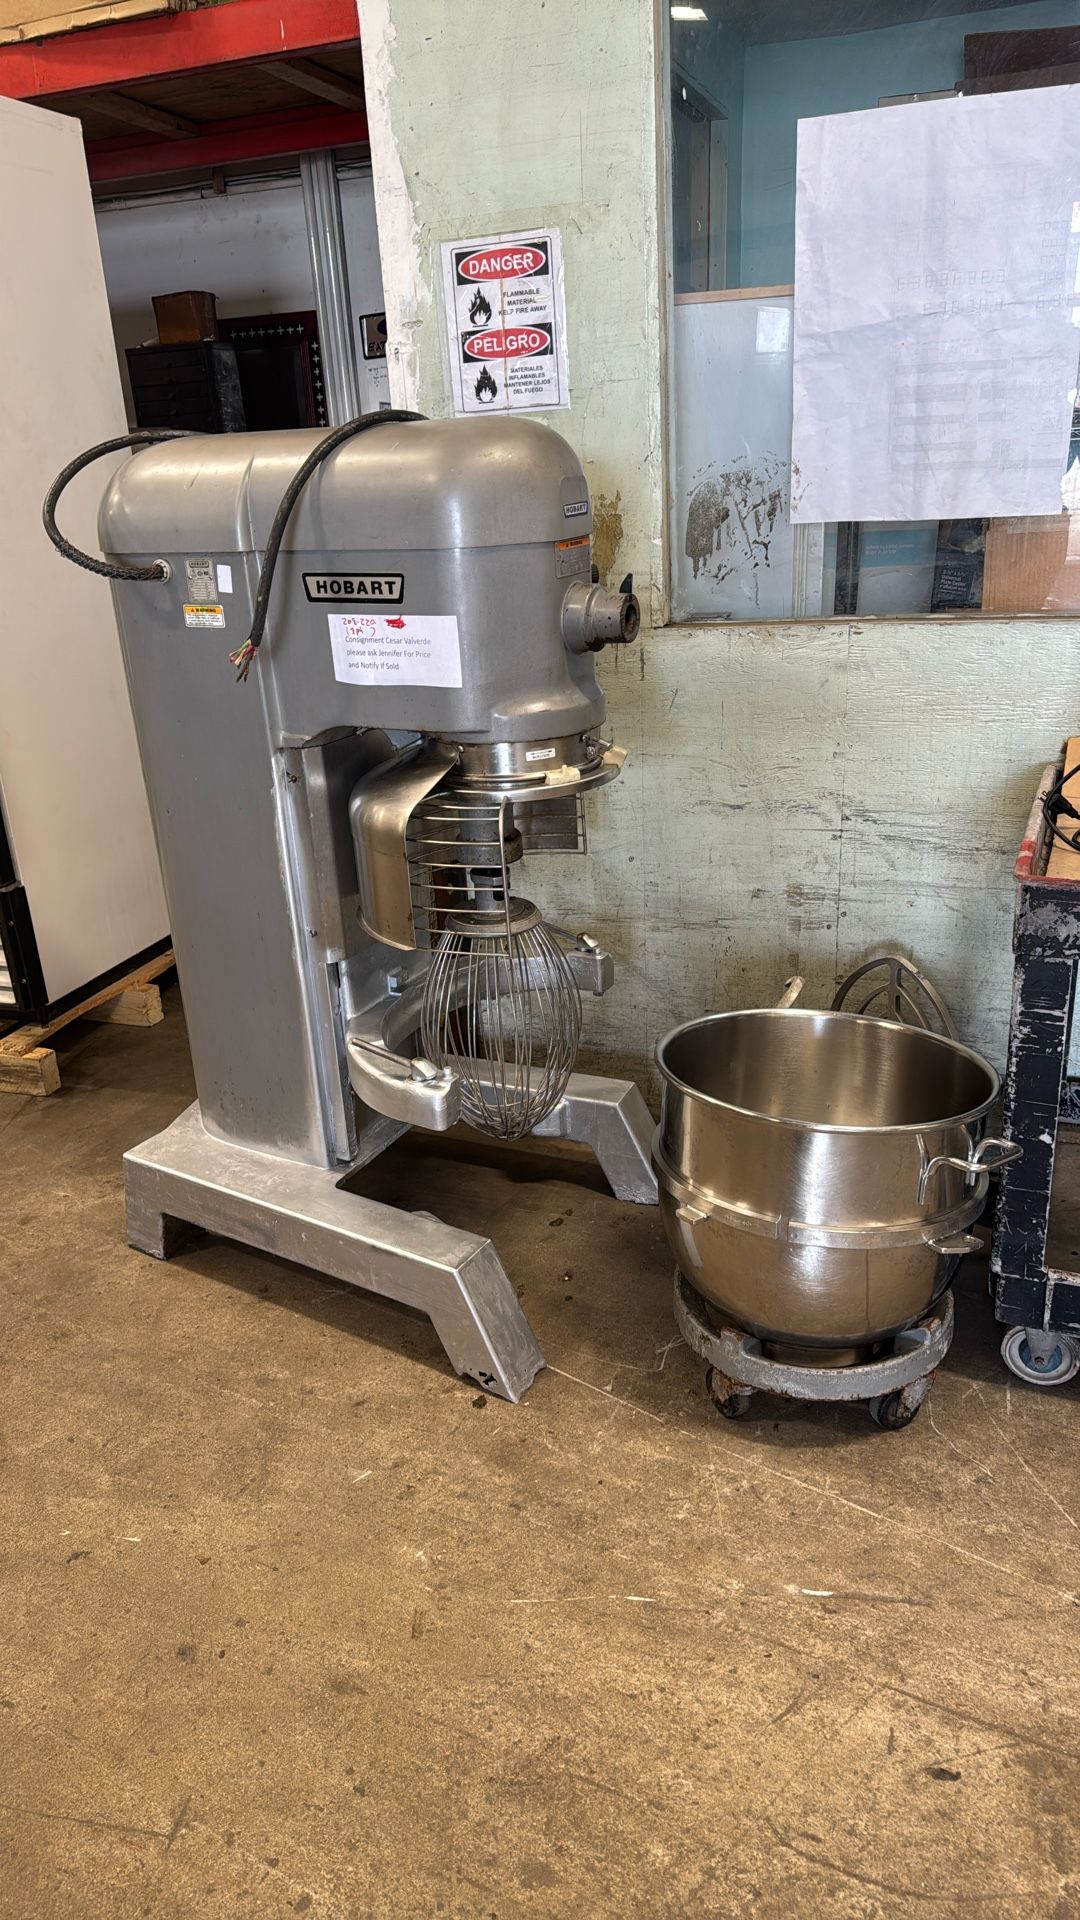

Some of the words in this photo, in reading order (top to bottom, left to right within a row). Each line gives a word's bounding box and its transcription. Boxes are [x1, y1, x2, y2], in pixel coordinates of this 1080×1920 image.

[469, 252, 535, 275] DANGER
[503, 288, 540, 298] FLAMMABLE
[507, 298, 536, 306] MATERIAL
[499, 308, 514, 316] KEEP
[516, 306, 529, 314] FIRE
[530, 305, 547, 313] AWAY
[474, 333, 540, 354] PELIGRO
[510, 365, 543, 374] MATERIALES
[509, 372, 546, 381] INFLAMABLES
[504, 380, 532, 388] MANTENER
[566, 504, 586, 514] HOBART
[316, 580, 396, 595] HOBART
[345, 636, 384, 644] Consignment
[403, 637, 431, 645] Valverde
[347, 650, 366, 658] please
[361, 662, 379, 671] Notify
